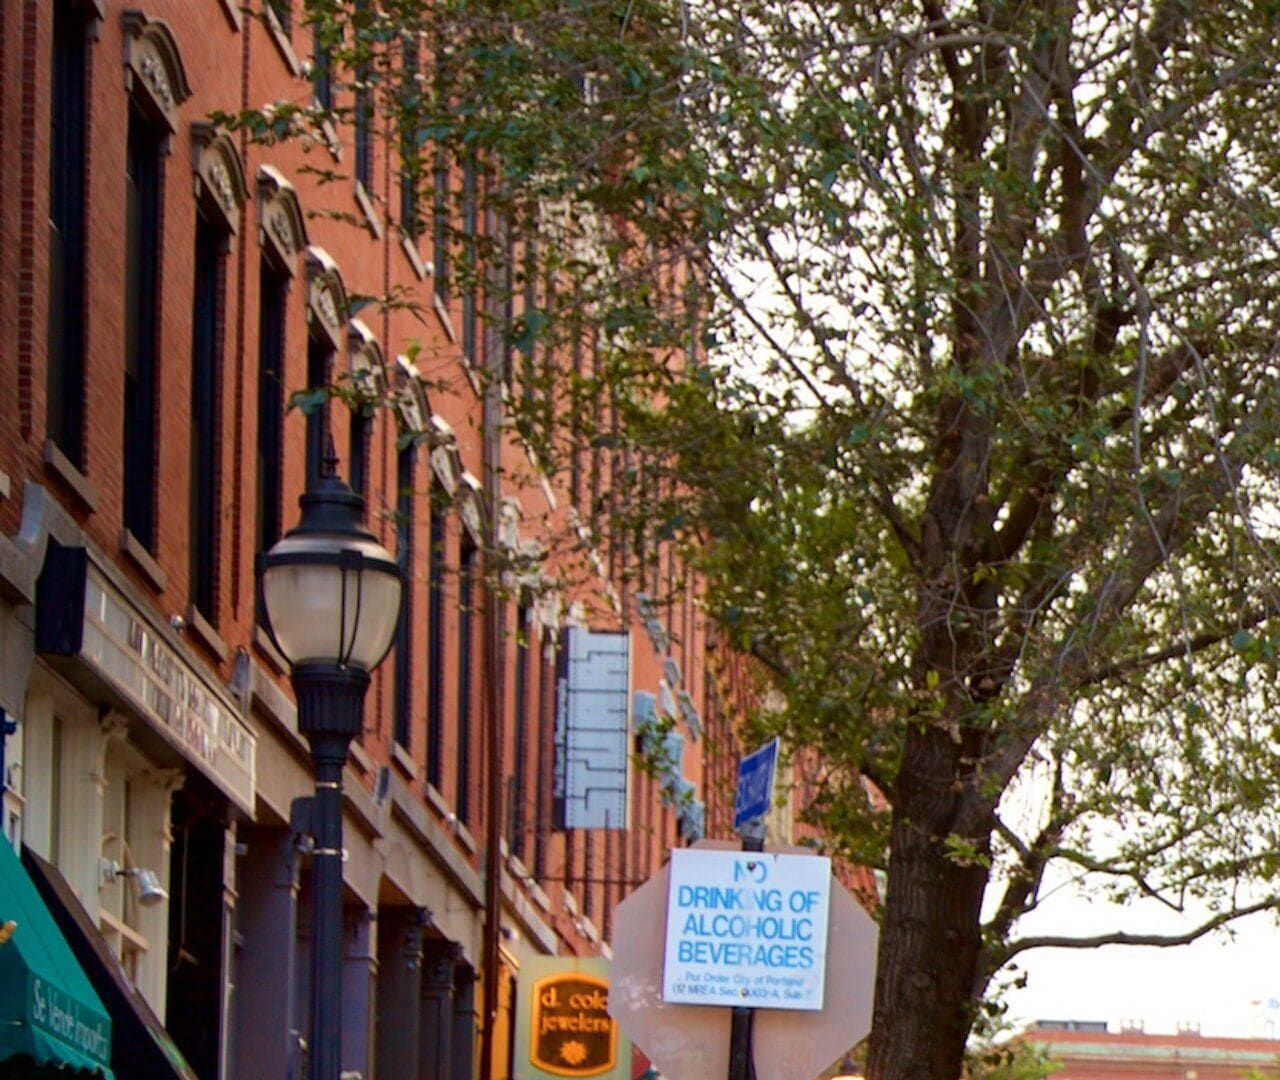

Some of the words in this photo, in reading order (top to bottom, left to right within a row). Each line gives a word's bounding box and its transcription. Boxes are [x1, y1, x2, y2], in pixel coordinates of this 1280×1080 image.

[733, 860, 767, 883] NO
[678, 885, 782, 912] DRINKNG
[789, 890, 820, 913] OF
[683, 913, 812, 941] ALCOHOLIC
[678, 941, 814, 968] BEVERAGES
[569, 989, 608, 1009] cole
[541, 1012, 610, 1035] jewelers
